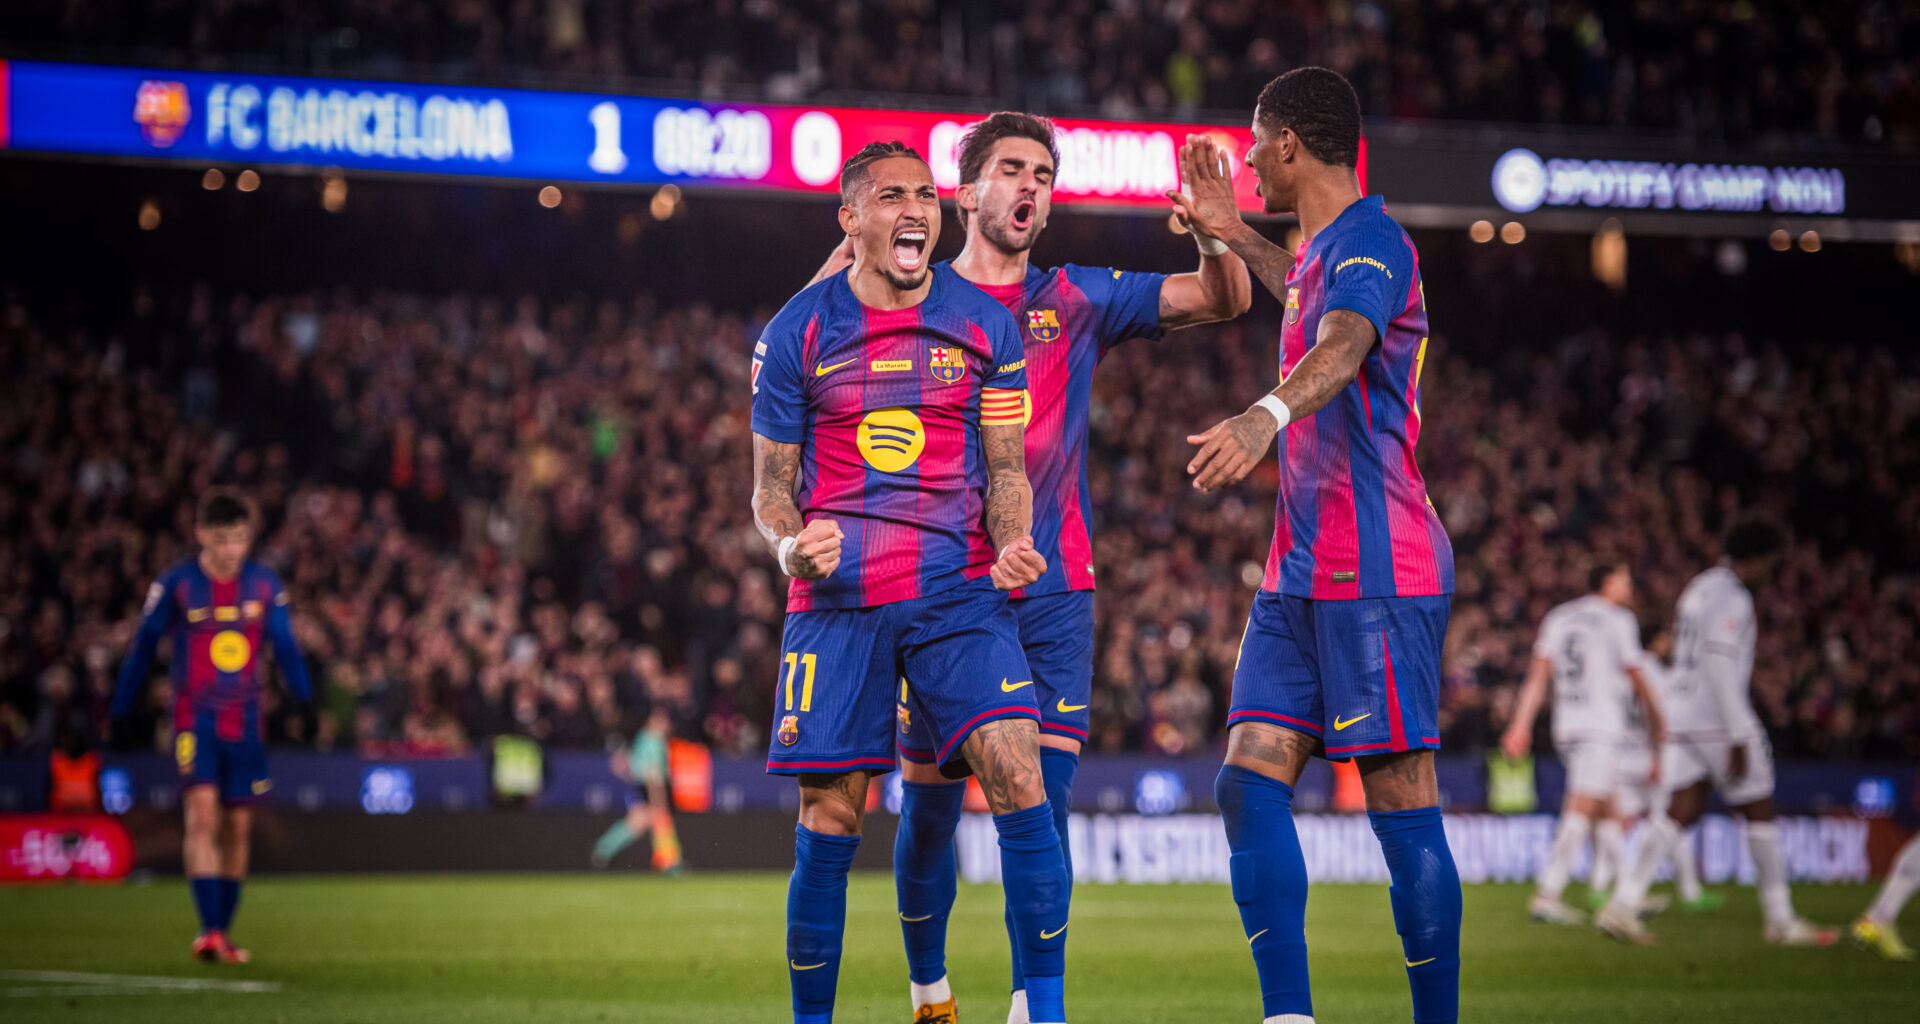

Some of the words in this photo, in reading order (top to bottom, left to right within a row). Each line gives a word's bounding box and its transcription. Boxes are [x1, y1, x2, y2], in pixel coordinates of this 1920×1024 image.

[207, 84, 262, 149] FC
[268, 87, 513, 162] BARCELONA
[589, 102, 628, 174] 1
[791, 111, 842, 187] 0
[1547, 158, 1674, 209] SPOTIFY
[1677, 163, 1771, 212] CAMP
[1771, 166, 1845, 214] NOU
[1335, 256, 1386, 274] AMBILIGHT
[784, 652, 817, 712] 11
